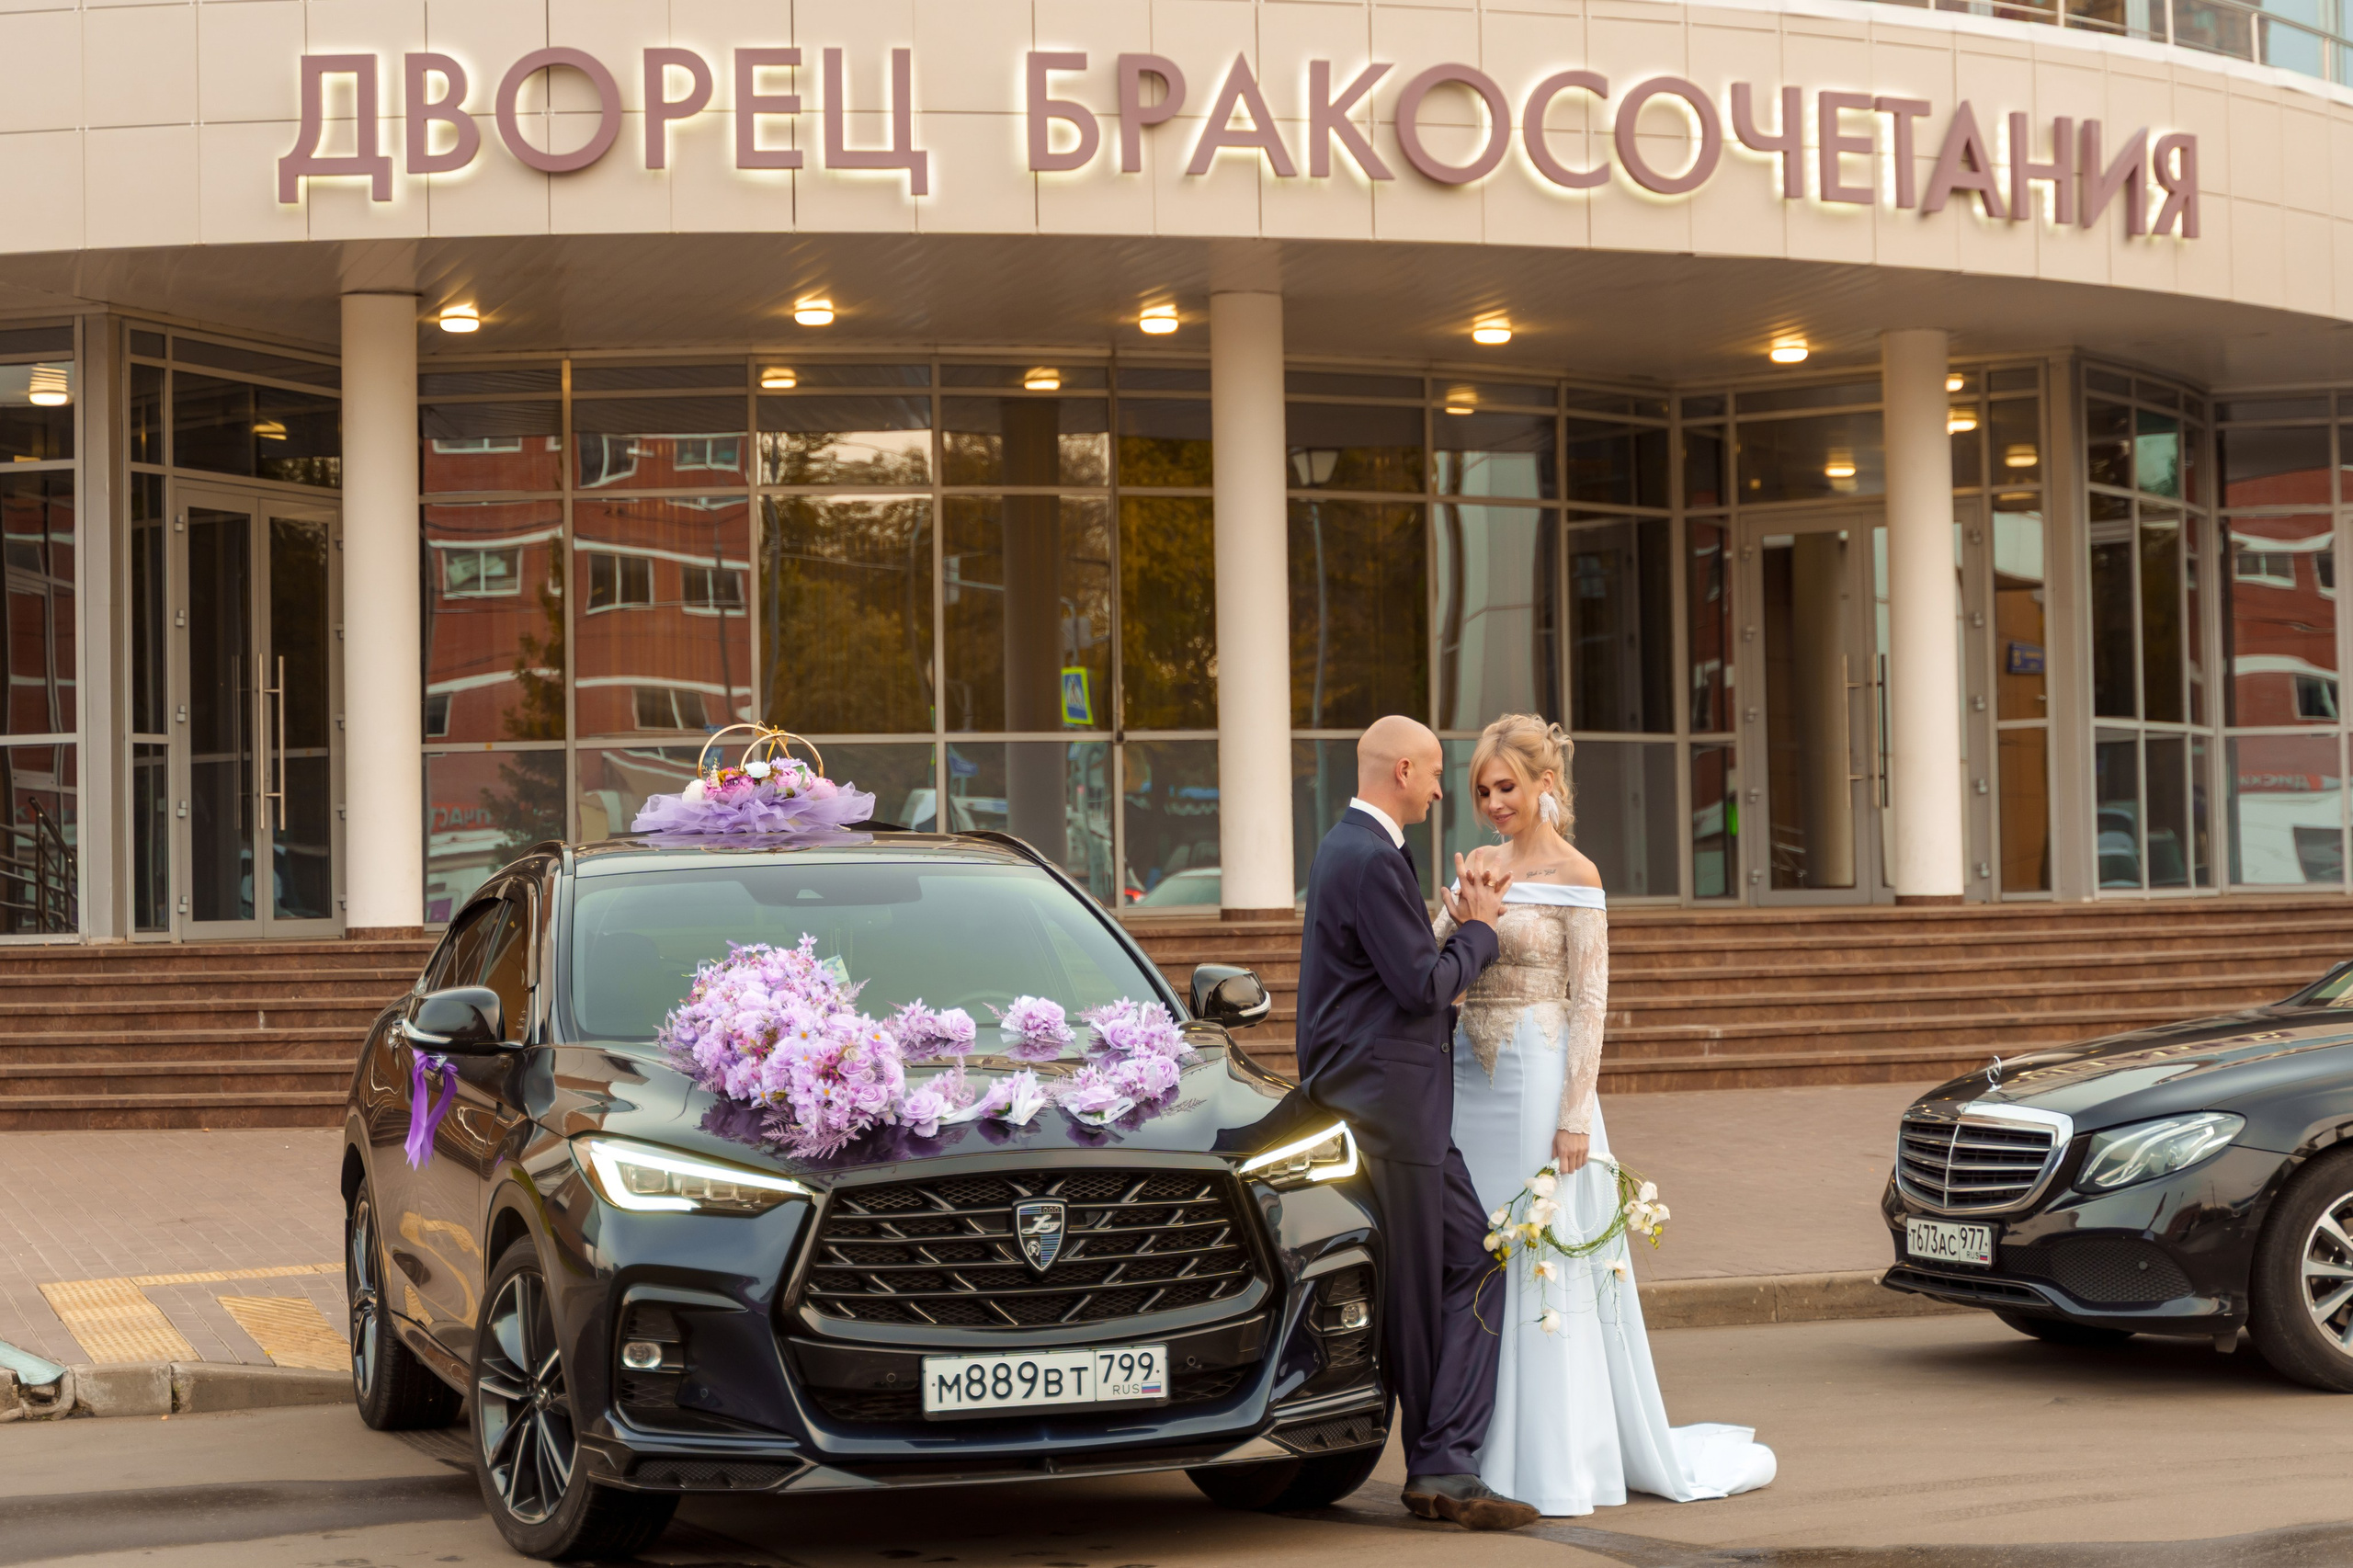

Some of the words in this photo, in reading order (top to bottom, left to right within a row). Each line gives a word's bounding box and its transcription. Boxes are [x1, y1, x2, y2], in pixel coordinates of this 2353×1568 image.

[278, 46, 928, 203] ДВОРЕЦ
[1027, 51, 2200, 239] БРАКОСОЧЕТАНИЯ
[1911, 1223, 1957, 1256] Т673АС
[1960, 1227, 1984, 1251] 977
[1966, 1251, 1980, 1260] RUS
[938, 1360, 1089, 1403] М889ВТ
[1099, 1351, 1154, 1383] 799
[1112, 1383, 1140, 1395] RUS
